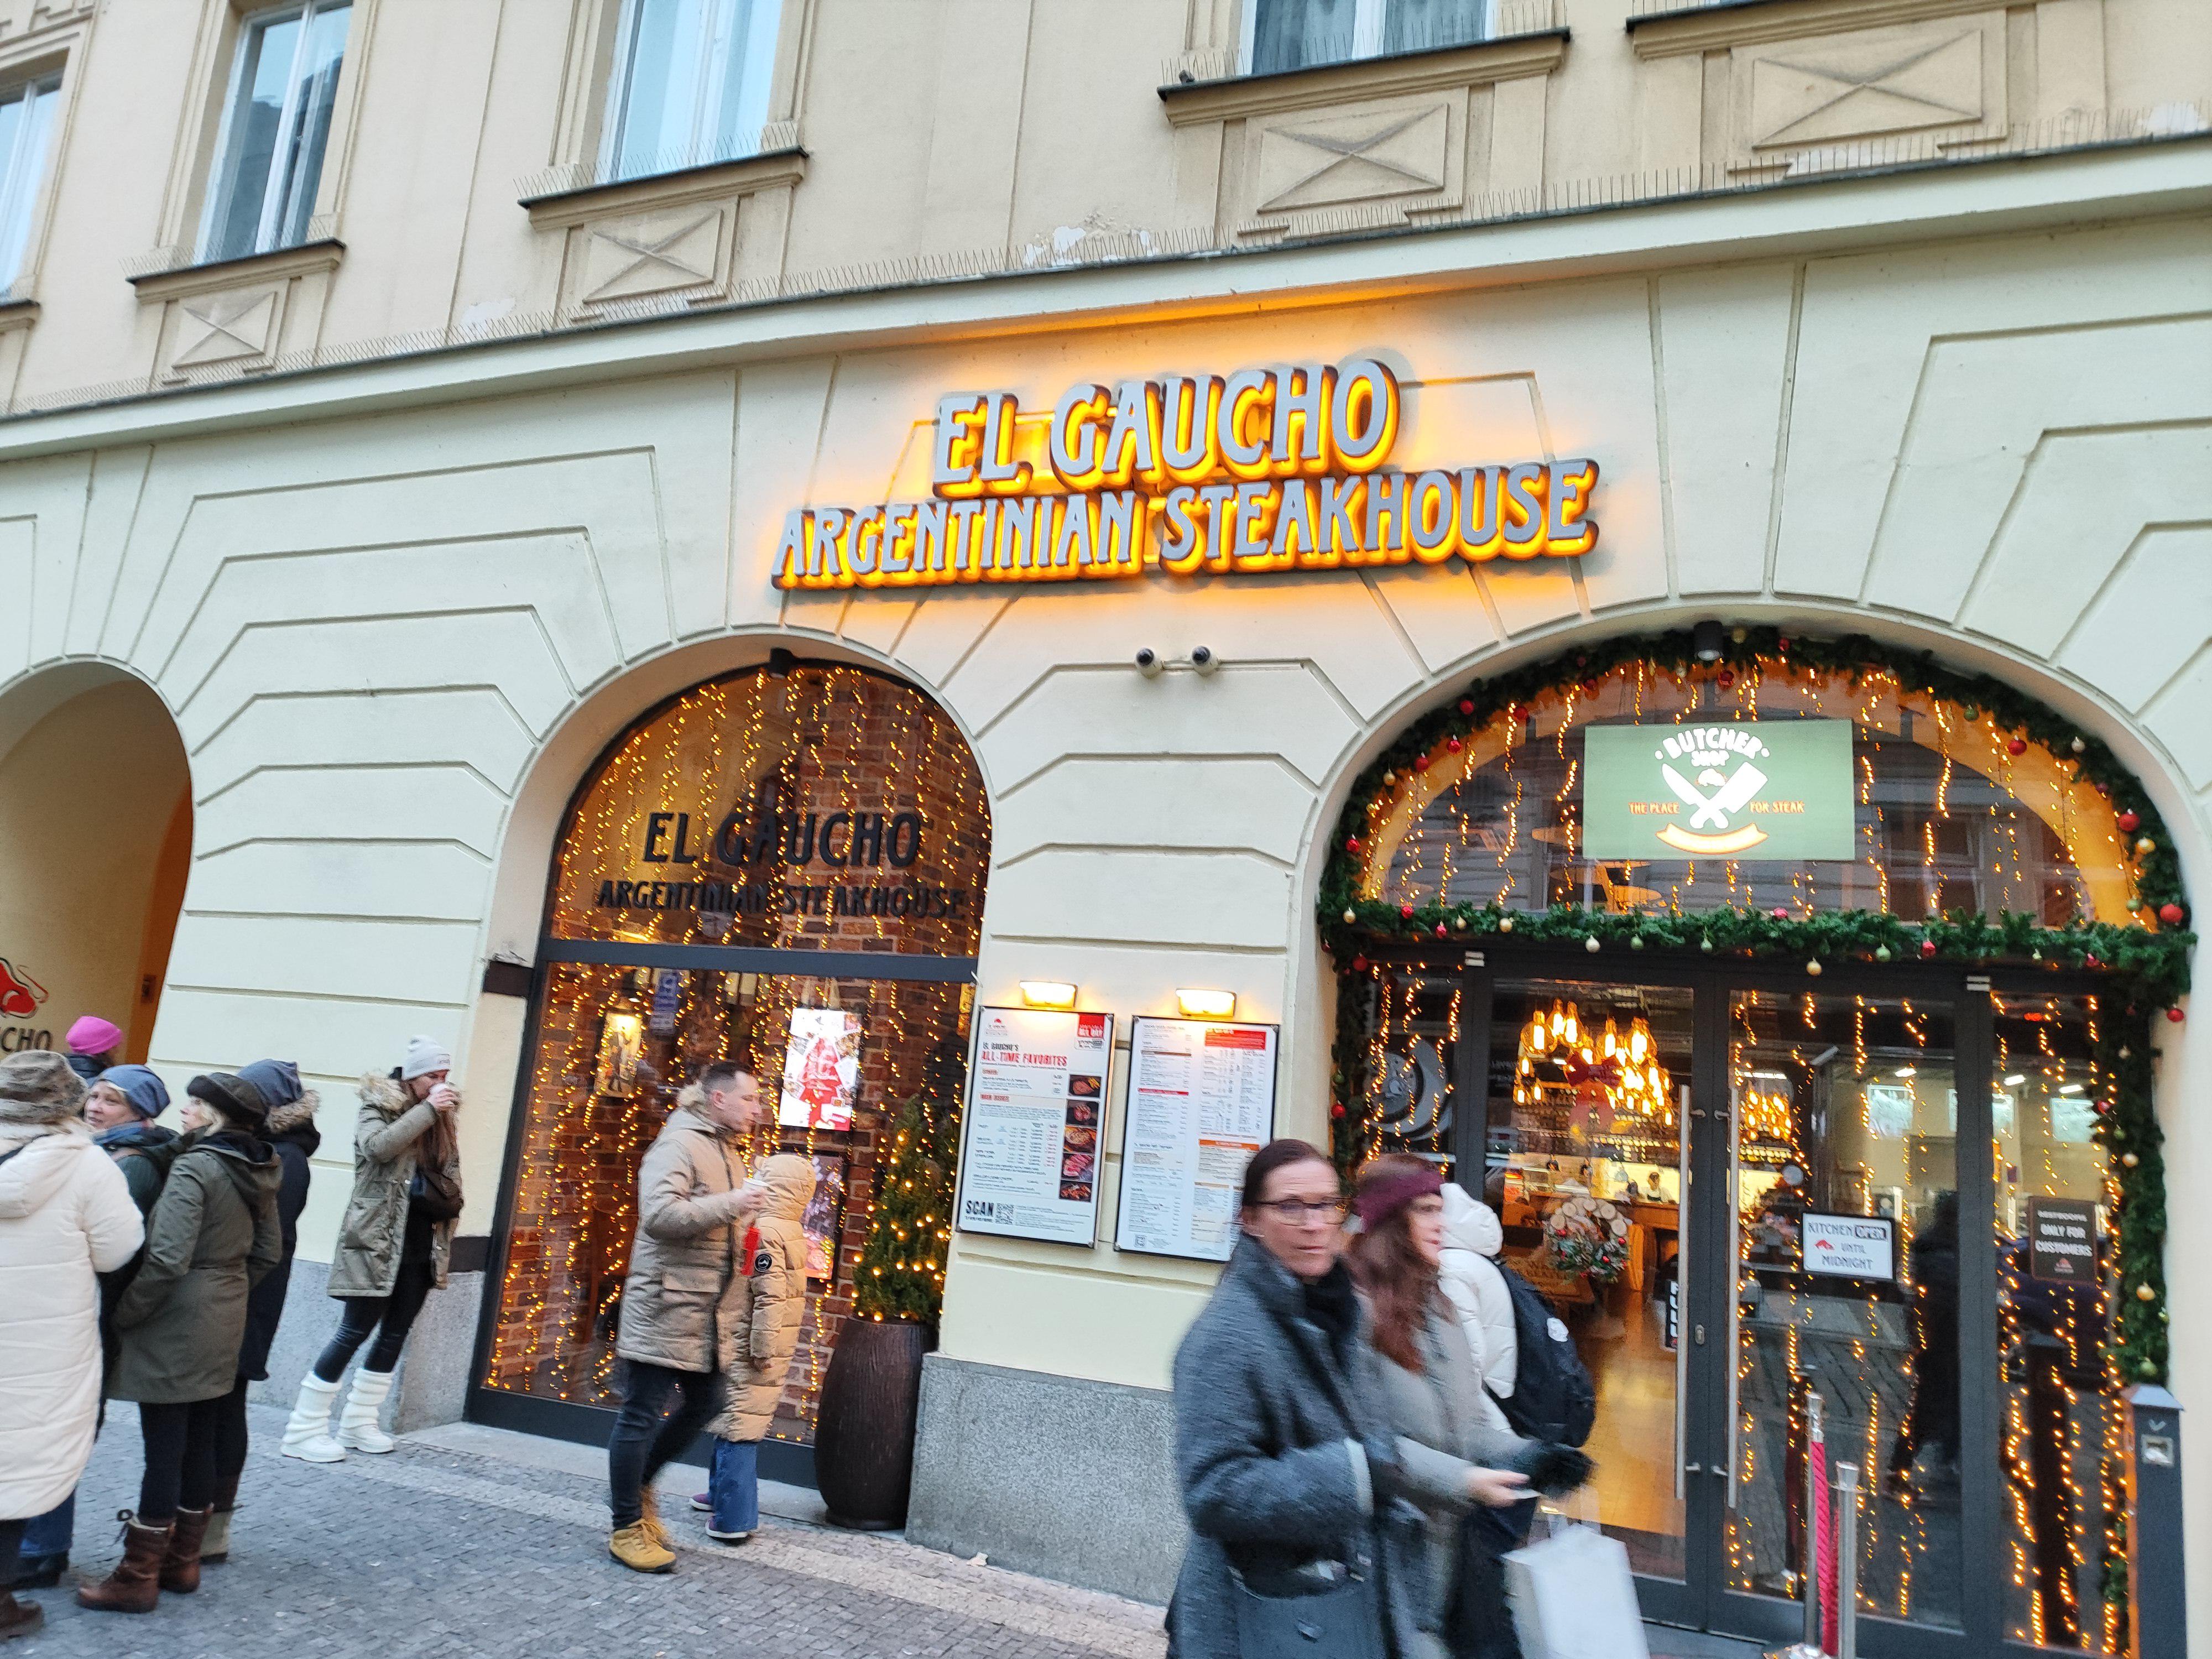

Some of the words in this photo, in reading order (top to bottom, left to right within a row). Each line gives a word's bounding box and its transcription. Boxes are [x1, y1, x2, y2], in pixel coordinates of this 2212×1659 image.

[933, 393, 1030, 492] EL
[1050, 358, 1400, 491] GAUCHO
[771, 489, 1147, 587] ARGENTINIAN
[1160, 458, 1599, 573] STEAKHOUSE
[1662, 727, 1764, 760] BUTCHER
[1628, 801, 1648, 815] THE
[1649, 801, 1681, 815] PLACE
[1749, 801, 1770, 813] FOR
[1771, 800, 1805, 813] STEAK
[643, 812, 697, 864] EL
[715, 812, 919, 868] GAUCHO
[598, 879, 769, 915] ARGENTINIAN
[781, 885, 966, 919] STEAKHOUSE
[0, 1026, 53, 1052] CHO
[966, 1200, 994, 1217] SCAN
[1808, 1222, 1853, 1237] KITCHEN
[1855, 1225, 1887, 1240] OPEN
[1822, 1254, 1874, 1270] MIDNIGHT
